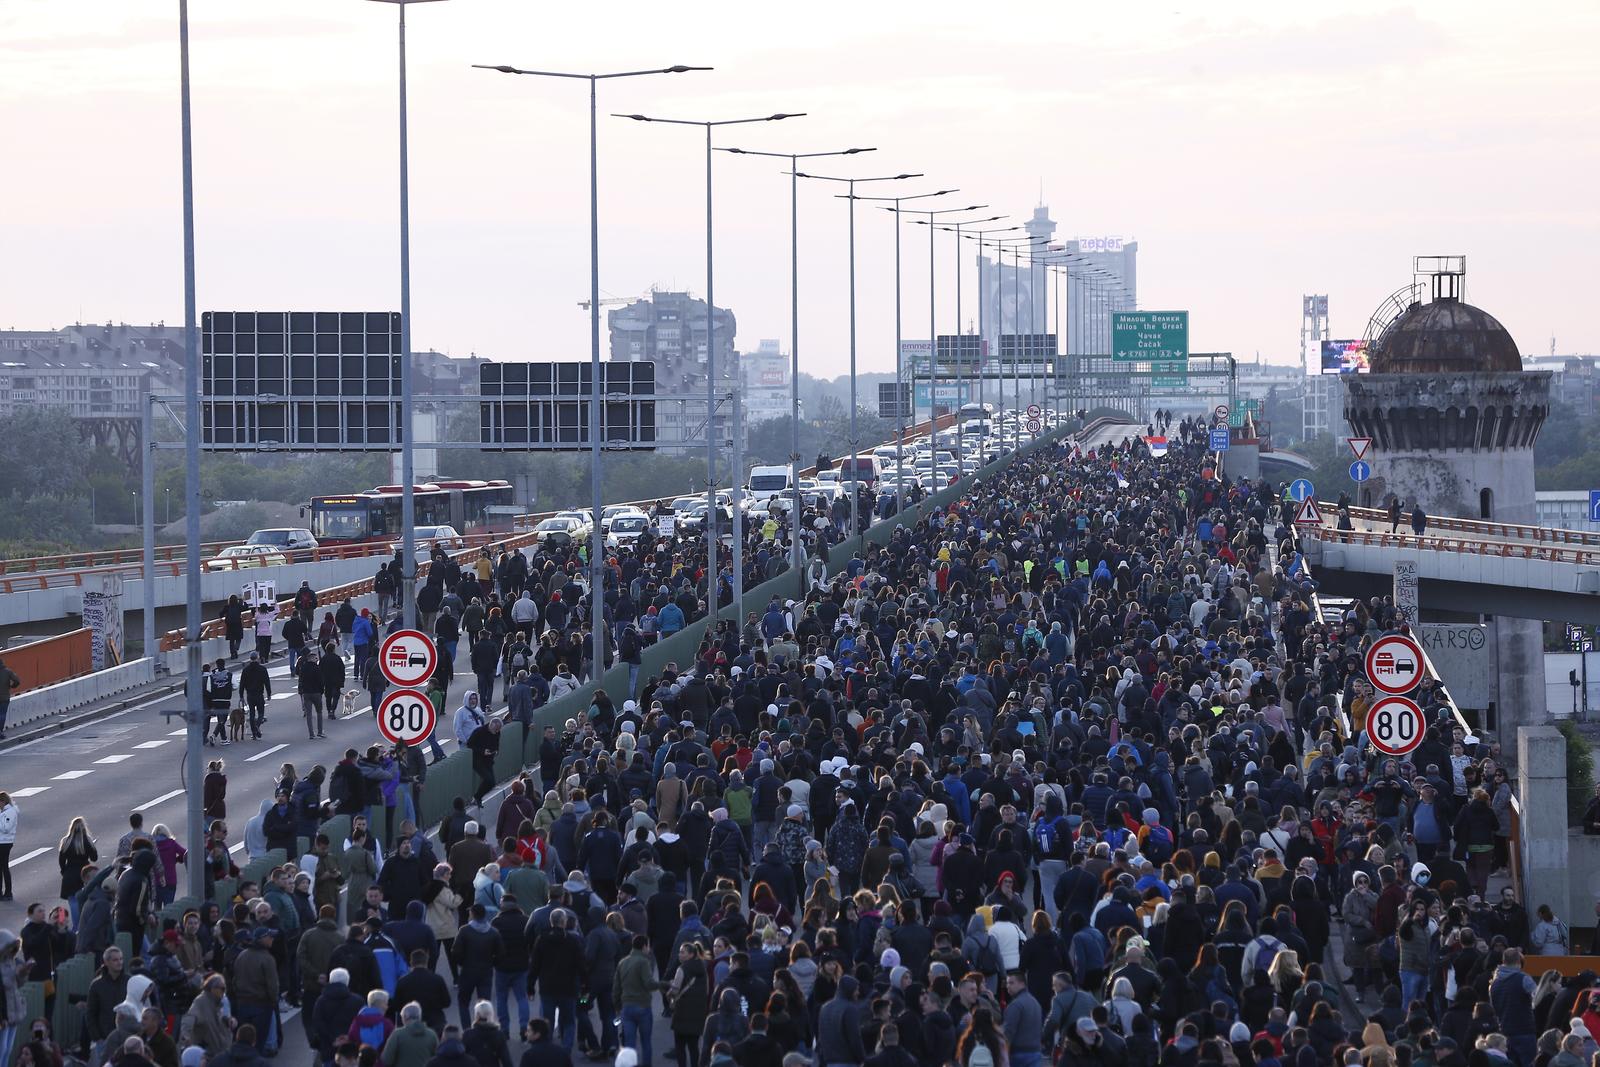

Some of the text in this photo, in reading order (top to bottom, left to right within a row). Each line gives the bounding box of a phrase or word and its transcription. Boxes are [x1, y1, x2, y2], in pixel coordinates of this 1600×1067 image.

[1029, 422, 1038, 430] 80
[390, 703, 423, 731] 80
[1378, 711, 1413, 740] 80
